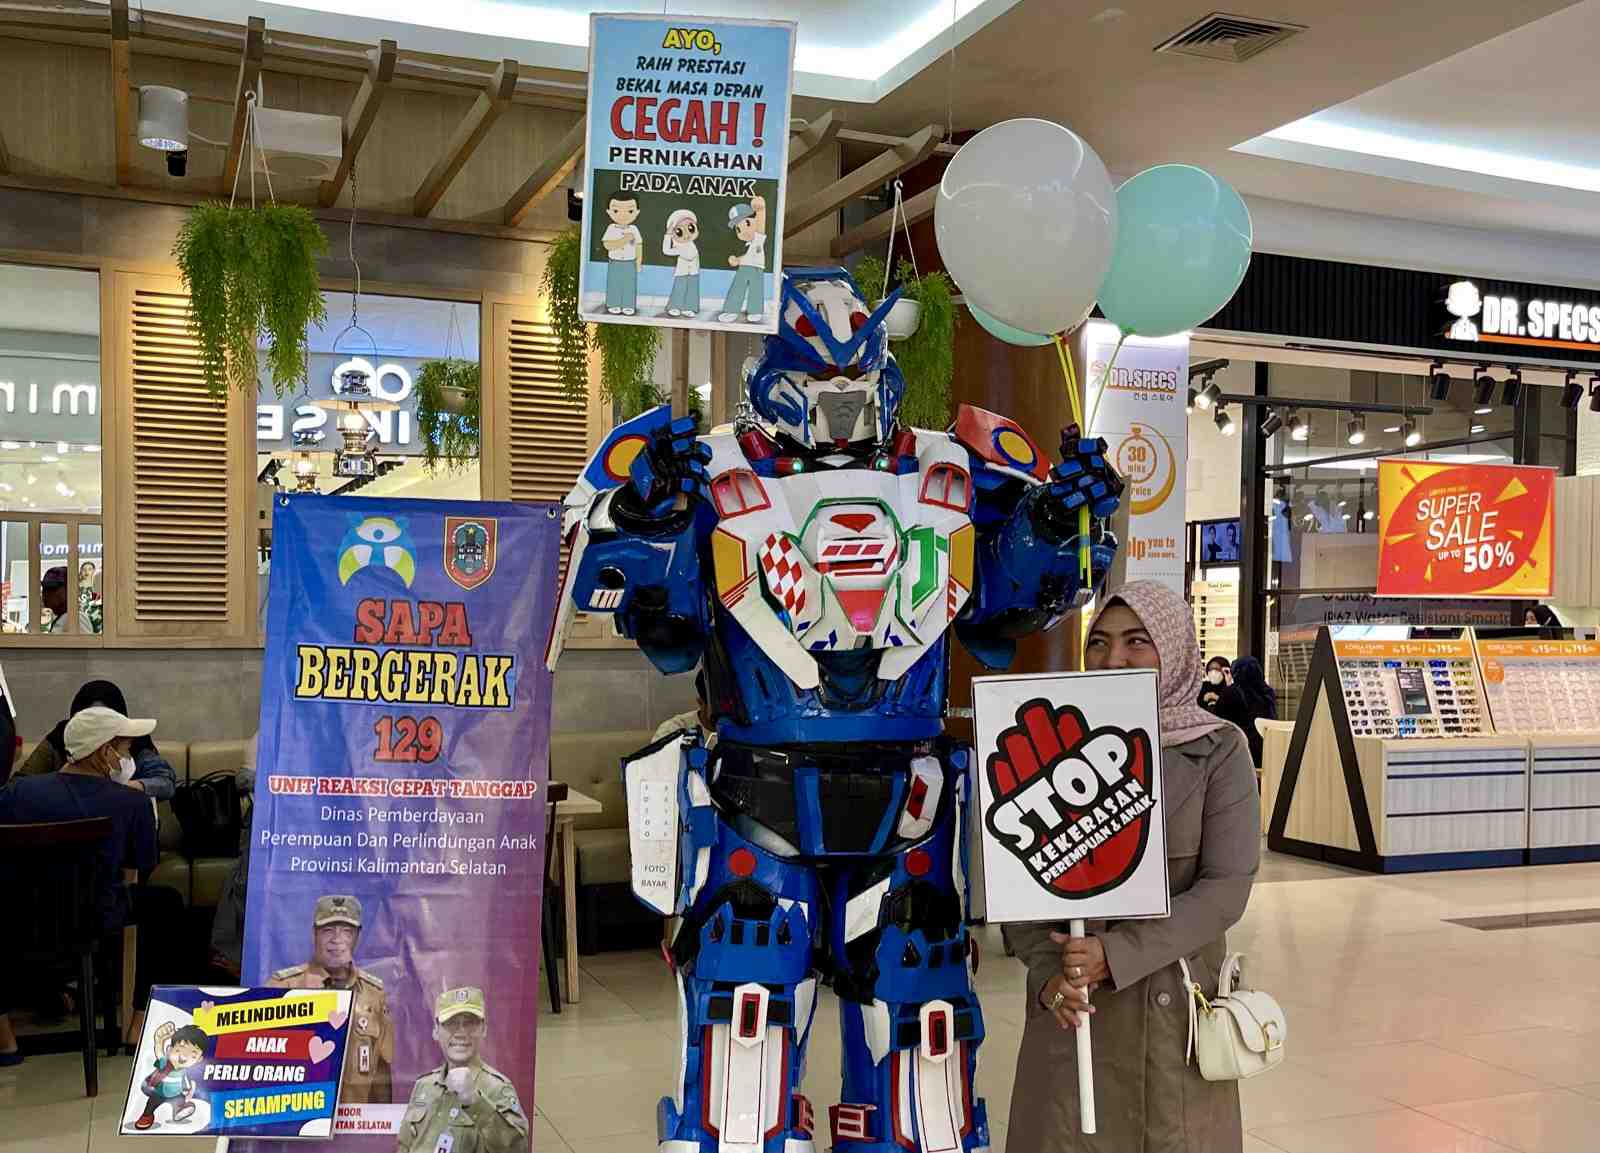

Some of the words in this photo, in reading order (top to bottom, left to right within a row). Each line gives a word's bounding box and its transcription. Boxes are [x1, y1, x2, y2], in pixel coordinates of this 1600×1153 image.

[663, 28, 722, 55] AYO,
[636, 56, 673, 71] RAIH
[677, 57, 746, 75] PRESTASI
[616, 77, 662, 94] BEKAL
[667, 80, 708, 96] MASA
[713, 82, 764, 98] DEPAN
[610, 96, 740, 146] CEGAH
[608, 146, 763, 171] PERNIKAHAN
[620, 173, 684, 194] PADA
[688, 175, 757, 197] ANAK
[1127, 446, 1146, 462] 30
[1416, 492, 1481, 520] SUPER
[1425, 511, 1498, 550] SALE
[1463, 541, 1515, 573] 50%
[353, 598, 472, 647] SAPA
[295, 643, 514, 708] BERGERAK
[373, 715, 444, 763] 129
[269, 776, 315, 795] UNIT
[317, 777, 388, 796] REAKSI
[390, 779, 447, 798] CEPAT
[450, 780, 537, 799] TANGGAP
[993, 733, 1128, 851] STOP
[320, 806, 362, 822] Dinas
[368, 807, 485, 828] Pemberdayaan
[1028, 778, 1145, 872] KEKERASAN
[261, 831, 351, 849] Perempuan
[358, 832, 388, 848] Dan
[393, 833, 495, 853] Perlindungan
[500, 834, 537, 850] Anak
[1040, 825, 1113, 884] PEREMPUAN
[1110, 819, 1123, 832] &
[1120, 794, 1154, 825] ANAK
[291, 857, 353, 873] Provinsi
[358, 858, 445, 874] Kalimantan
[449, 859, 506, 876] Selatan
[216, 1001, 314, 1028] MELINDUNGI
[245, 1037, 288, 1053] ANAK
[203, 1064, 250, 1081] PERLU
[252, 1065, 305, 1082] ORANG
[224, 1090, 325, 1119] SEKAMPUNG
[357, 1120, 392, 1130] SELATAN
